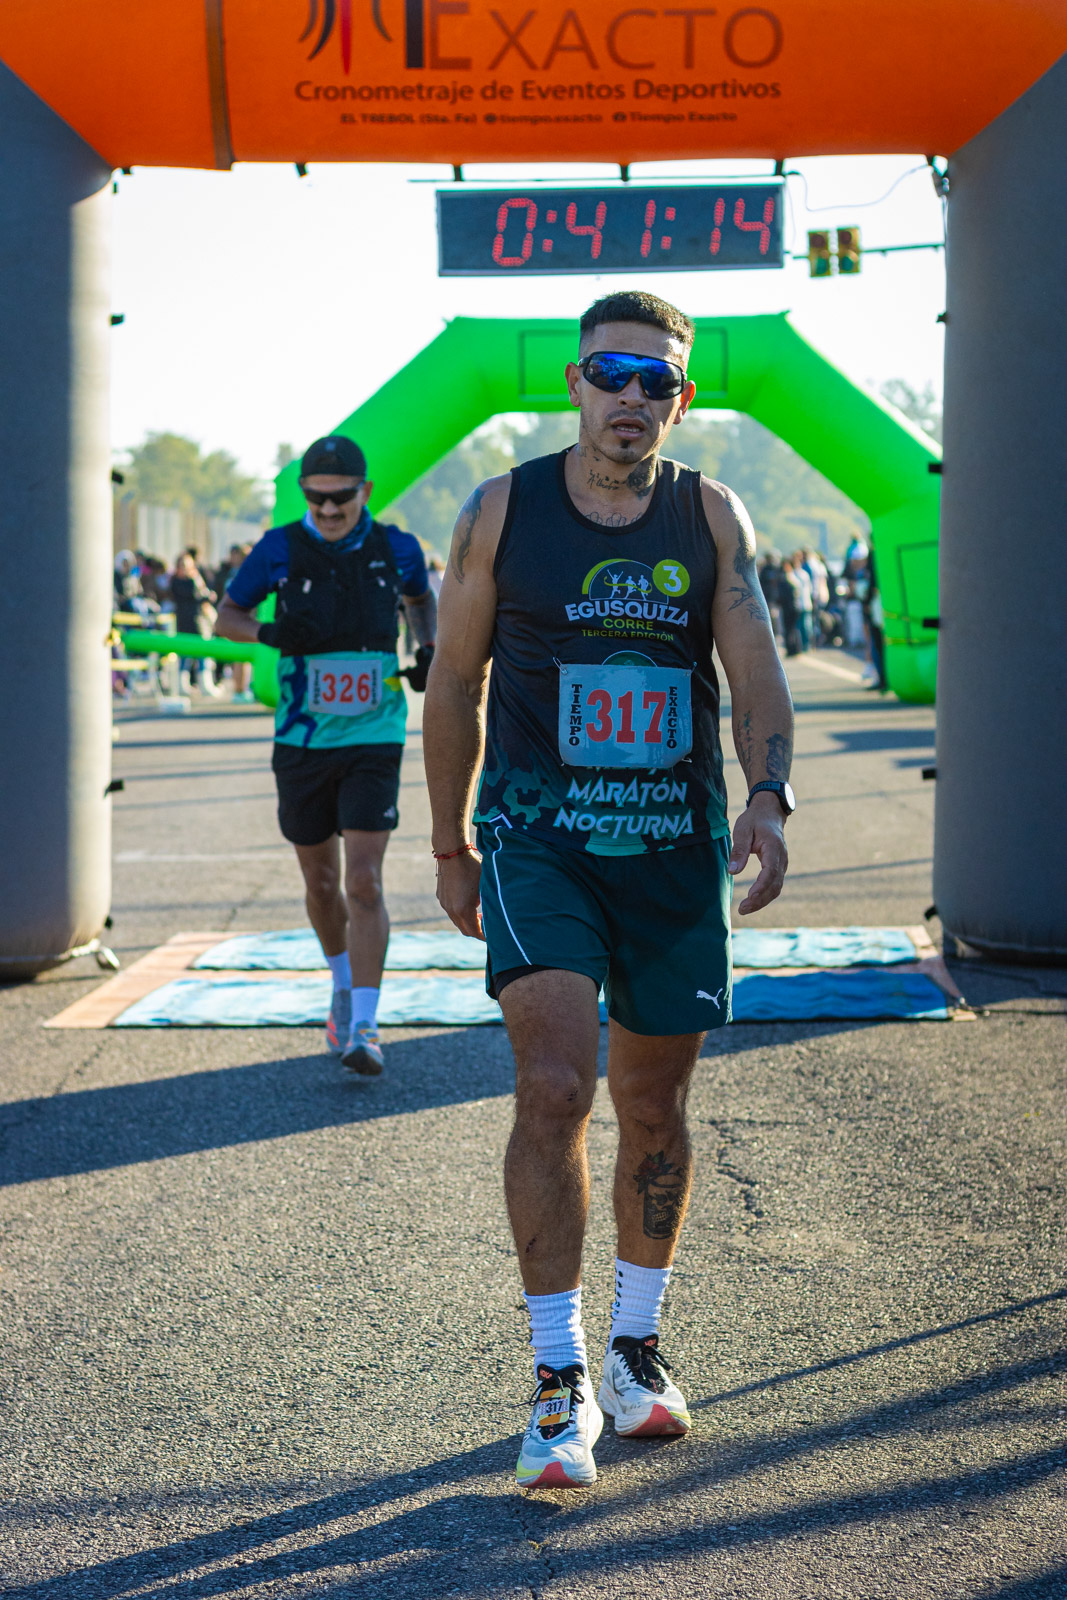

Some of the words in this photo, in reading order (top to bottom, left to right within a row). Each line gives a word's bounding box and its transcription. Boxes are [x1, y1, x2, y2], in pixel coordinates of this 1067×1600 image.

[295, 80, 475, 105] Cronometraje
[481, 80, 514, 101] de
[522, 80, 625, 101] Eventos
[634, 78, 782, 103] Deportivos
[630, 111, 686, 124] Tiempo
[688, 111, 738, 122] Exacto
[663, 565, 682, 593] 3
[565, 600, 689, 627] EGUSQUIZA
[603, 618, 654, 631] CORRE
[582, 629, 629, 638] TERCERA
[630, 631, 674, 641] EDICIÓN
[321, 672, 371, 703] 326
[568, 684, 583, 746] TIEMPO
[585, 689, 668, 744] 317
[666, 686, 678, 749] EXACTO
[566, 775, 688, 808] MARATÓN
[552, 805, 695, 840] NOCTURNA
[545, 1400, 564, 1414] 317
